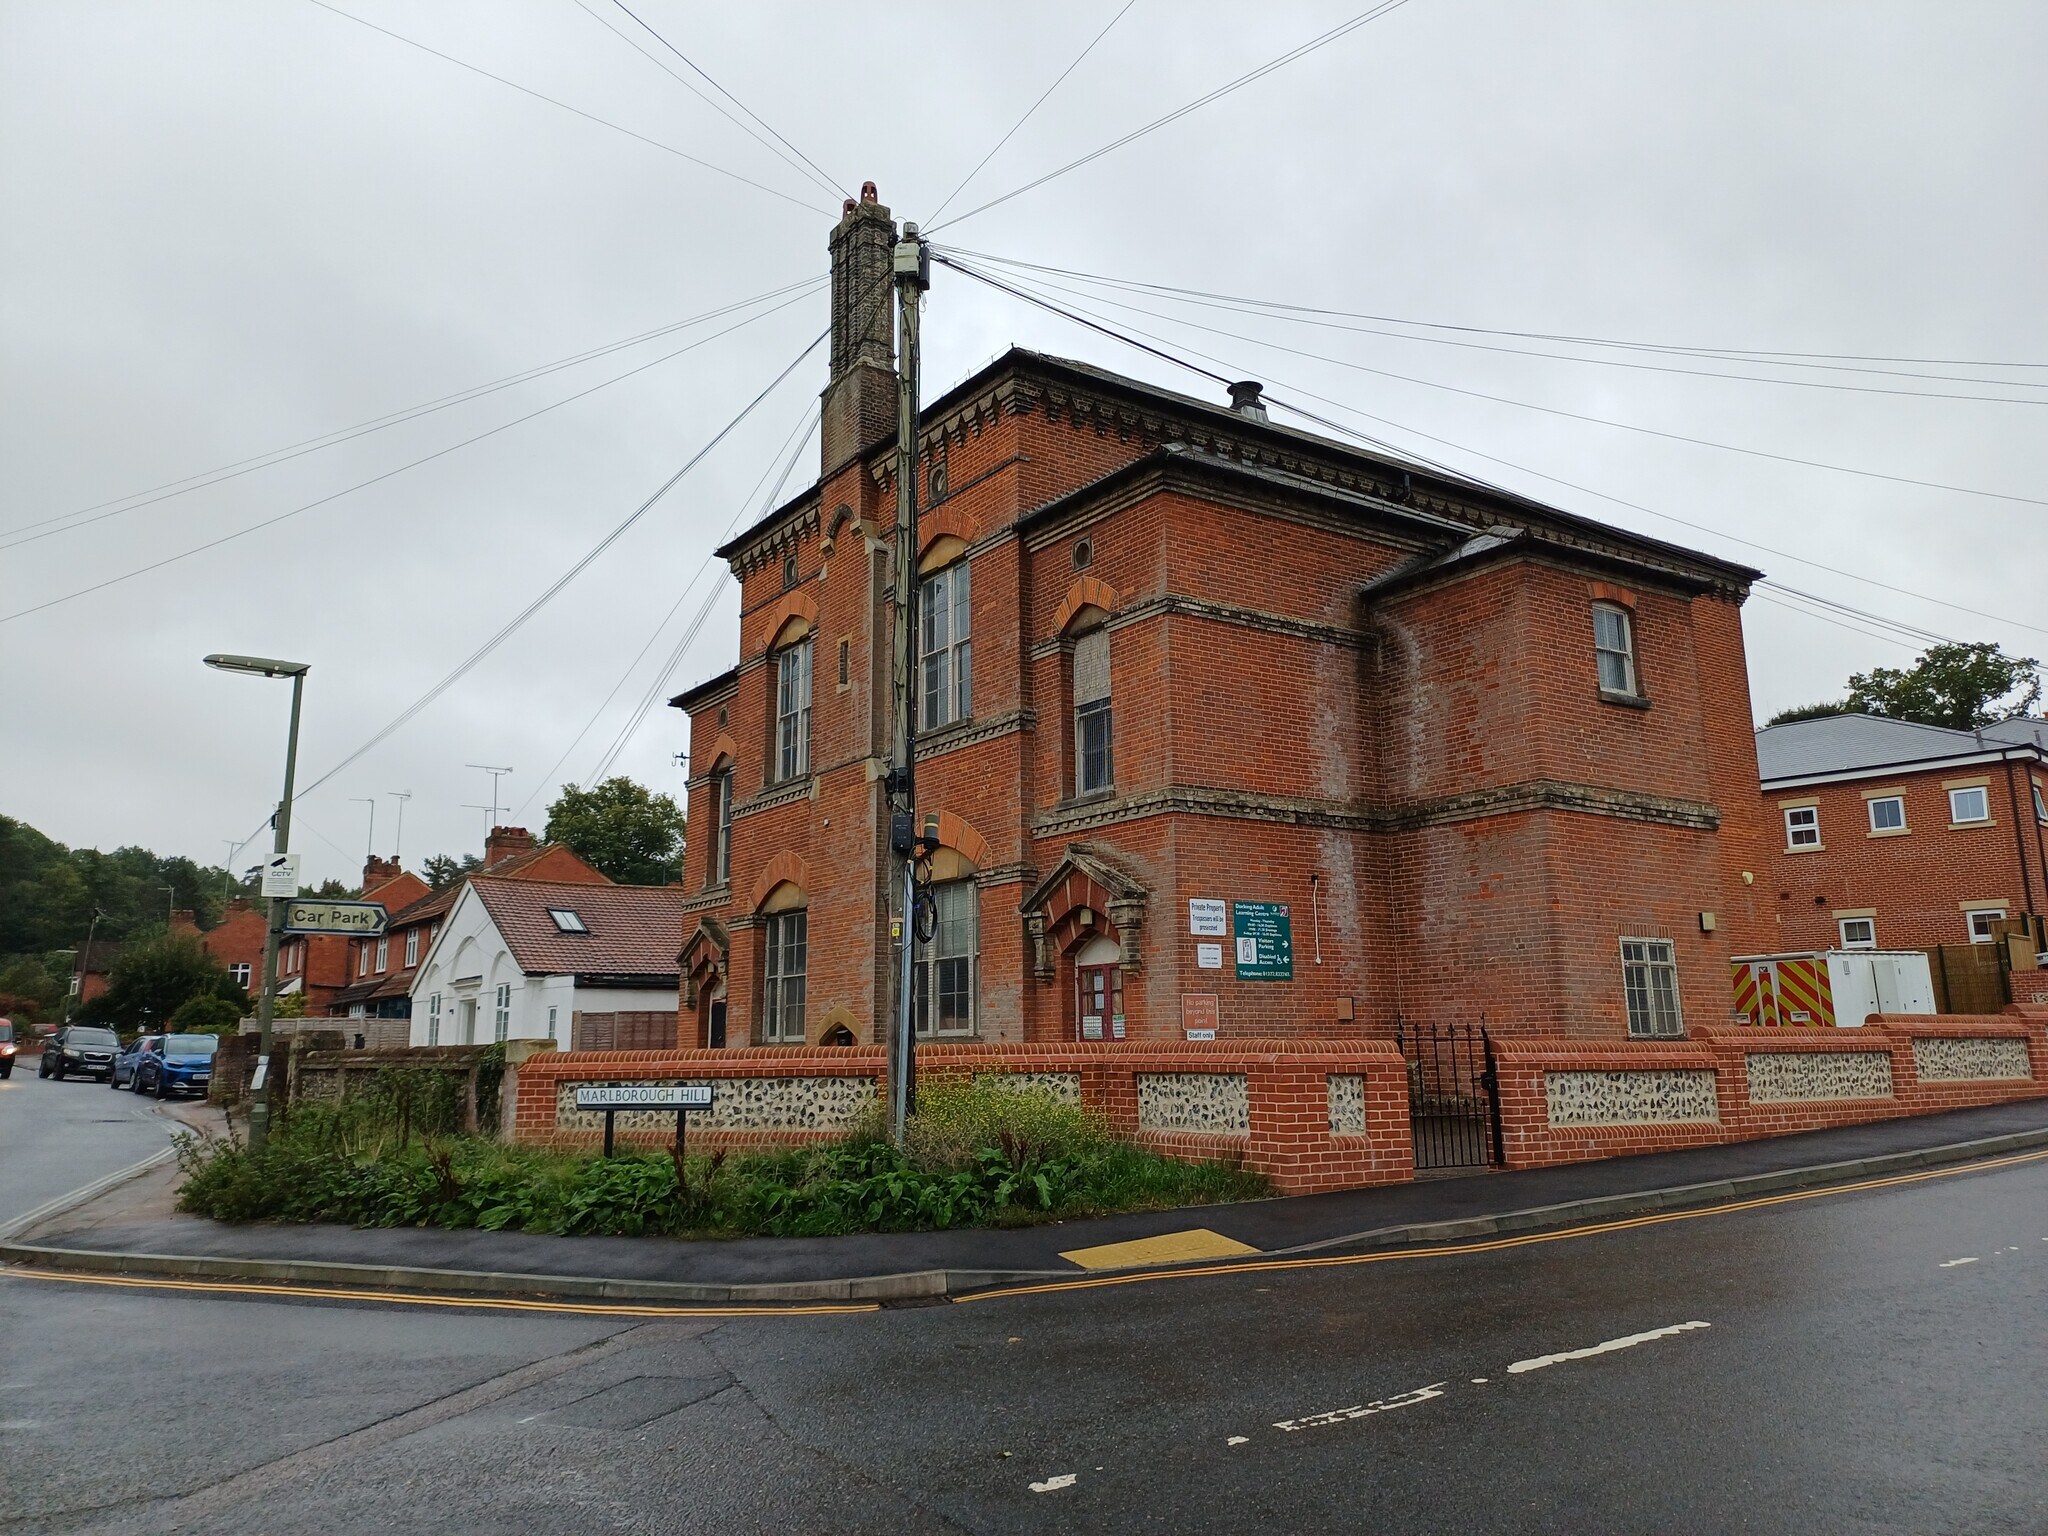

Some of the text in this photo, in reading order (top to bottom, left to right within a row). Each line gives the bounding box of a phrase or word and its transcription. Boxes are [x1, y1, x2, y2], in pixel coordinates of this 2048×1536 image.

[1207, 903, 1224, 913] Property
[294, 909, 370, 924] Car Park
[581, 1089, 708, 1101] MARLBOROUGH HILL
